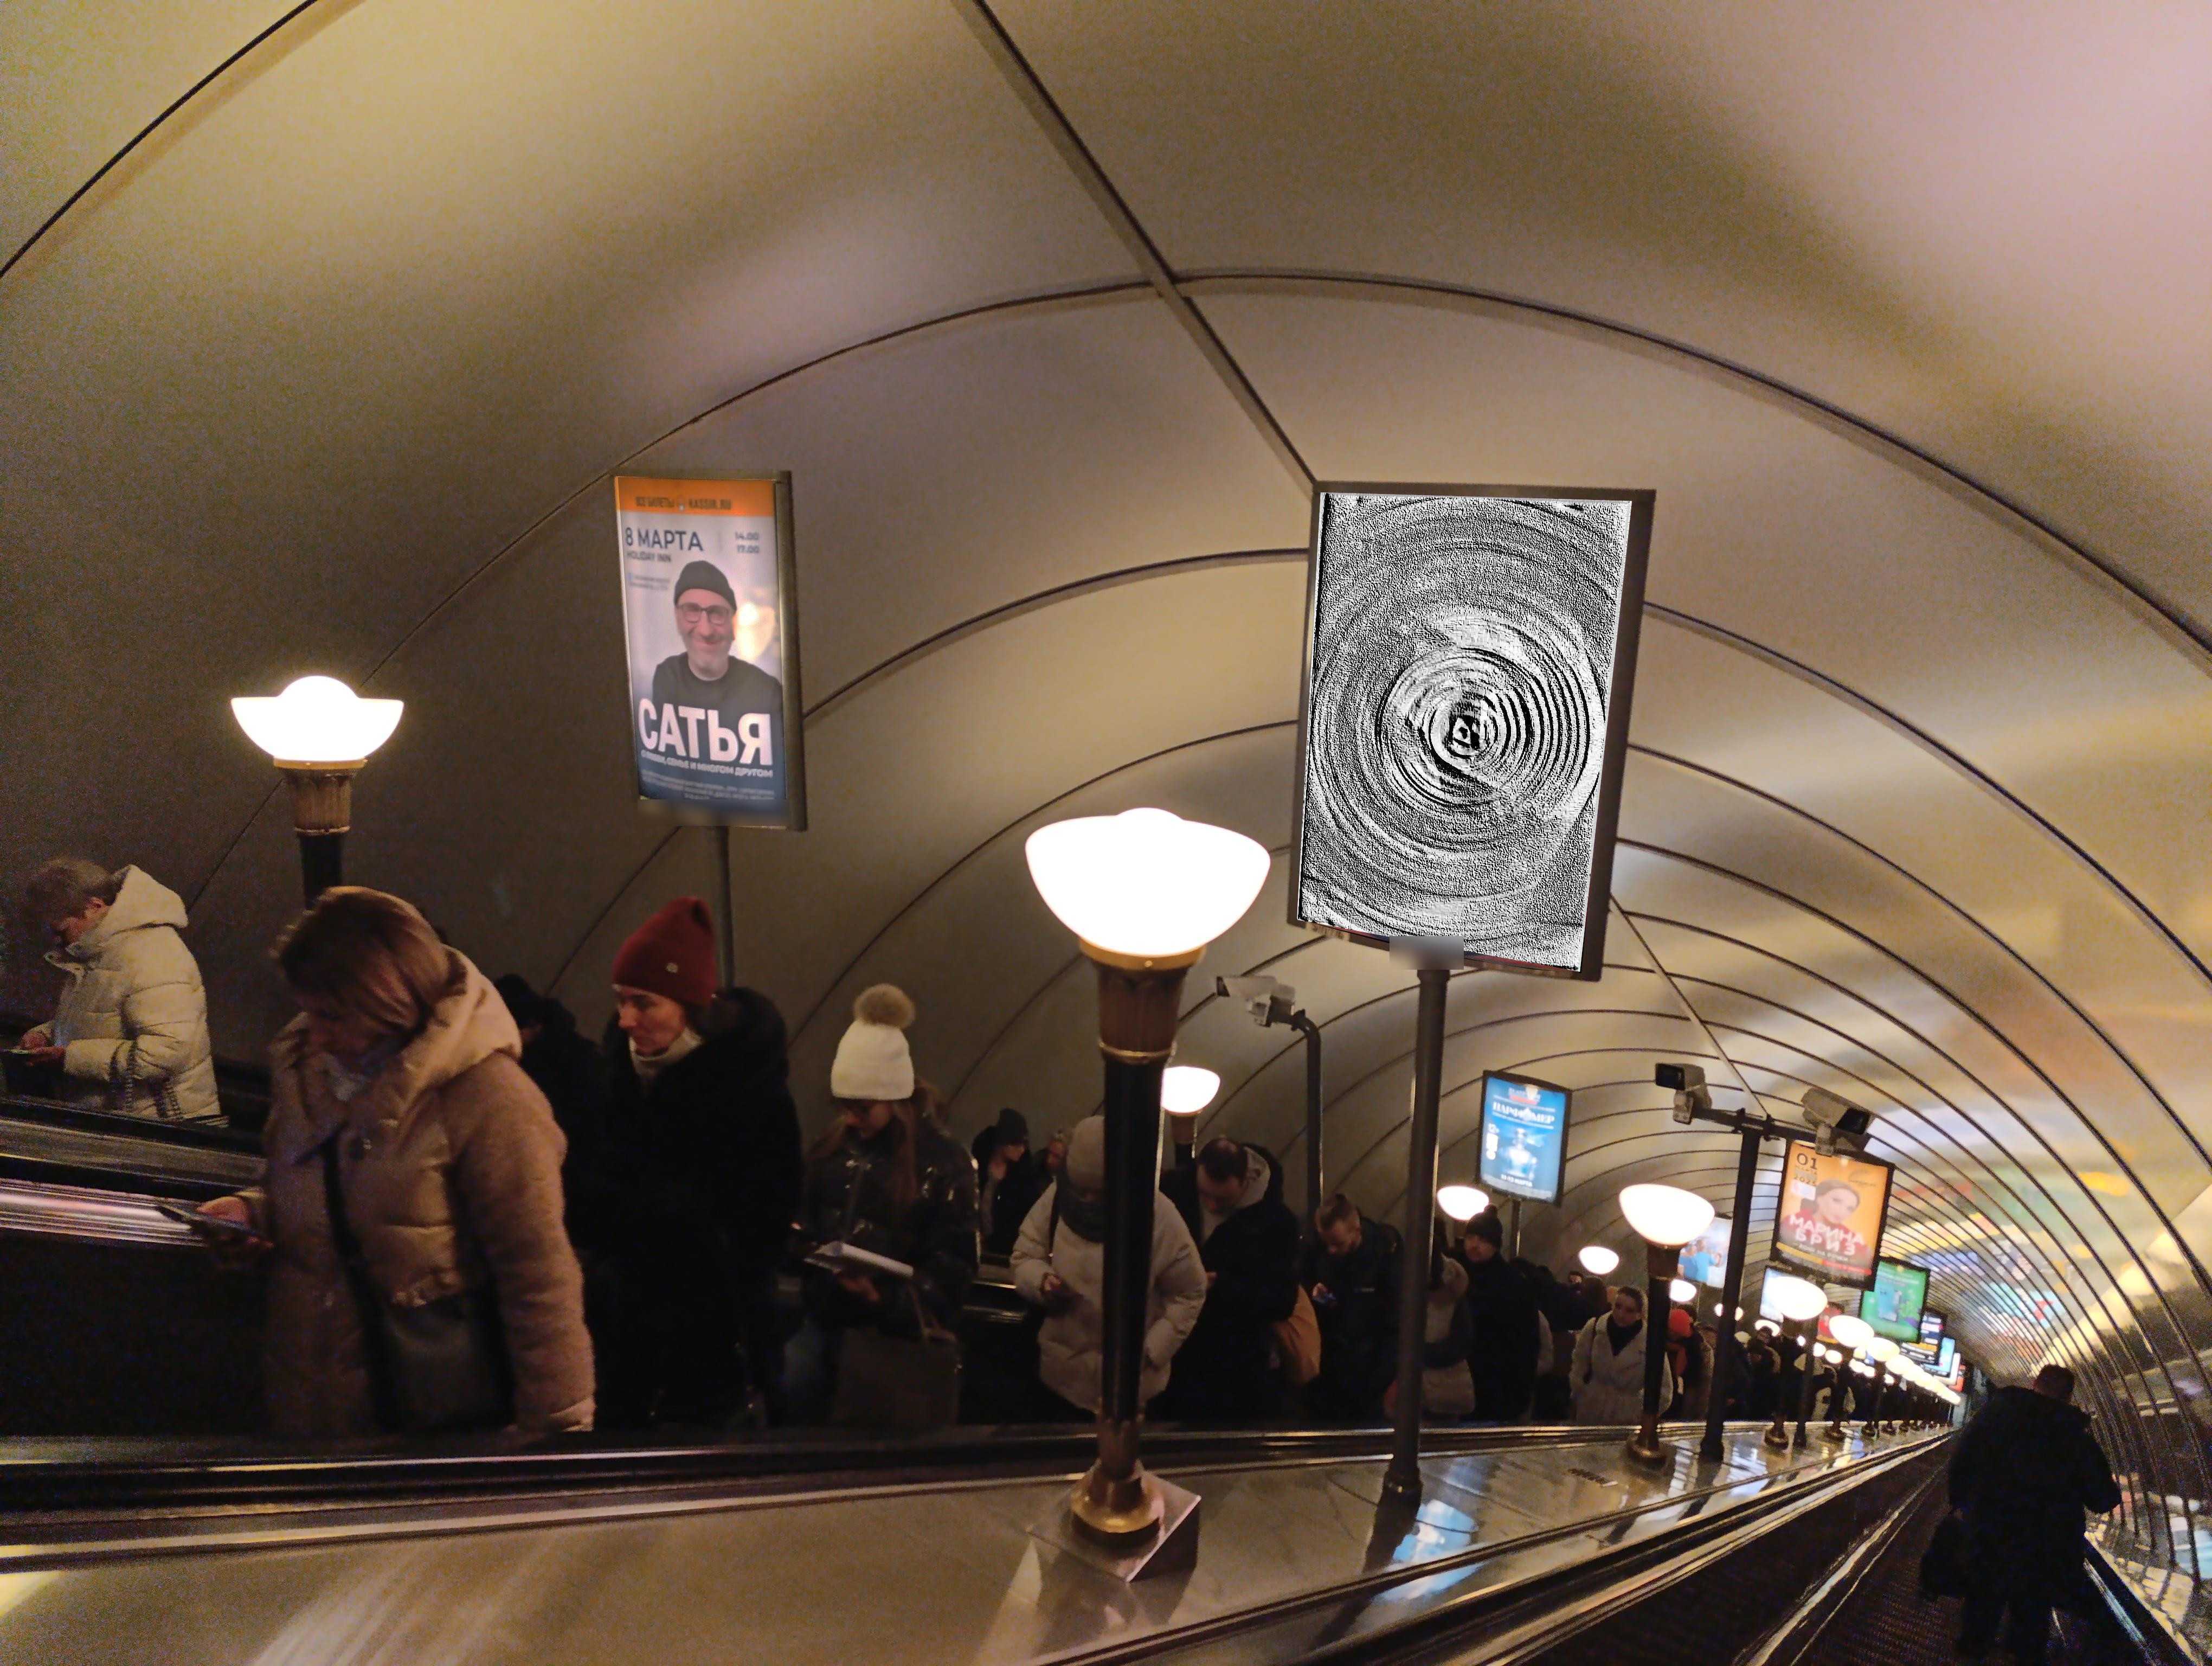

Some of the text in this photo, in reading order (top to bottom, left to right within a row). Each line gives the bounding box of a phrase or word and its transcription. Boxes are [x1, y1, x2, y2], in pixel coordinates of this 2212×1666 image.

[625, 527, 704, 552] 8 МАРТА
[638, 698, 773, 766] САТЬЯ
[1789, 1214, 1866, 1246] МАРИНА
[1795, 1228, 1855, 1256] БРИЗ
